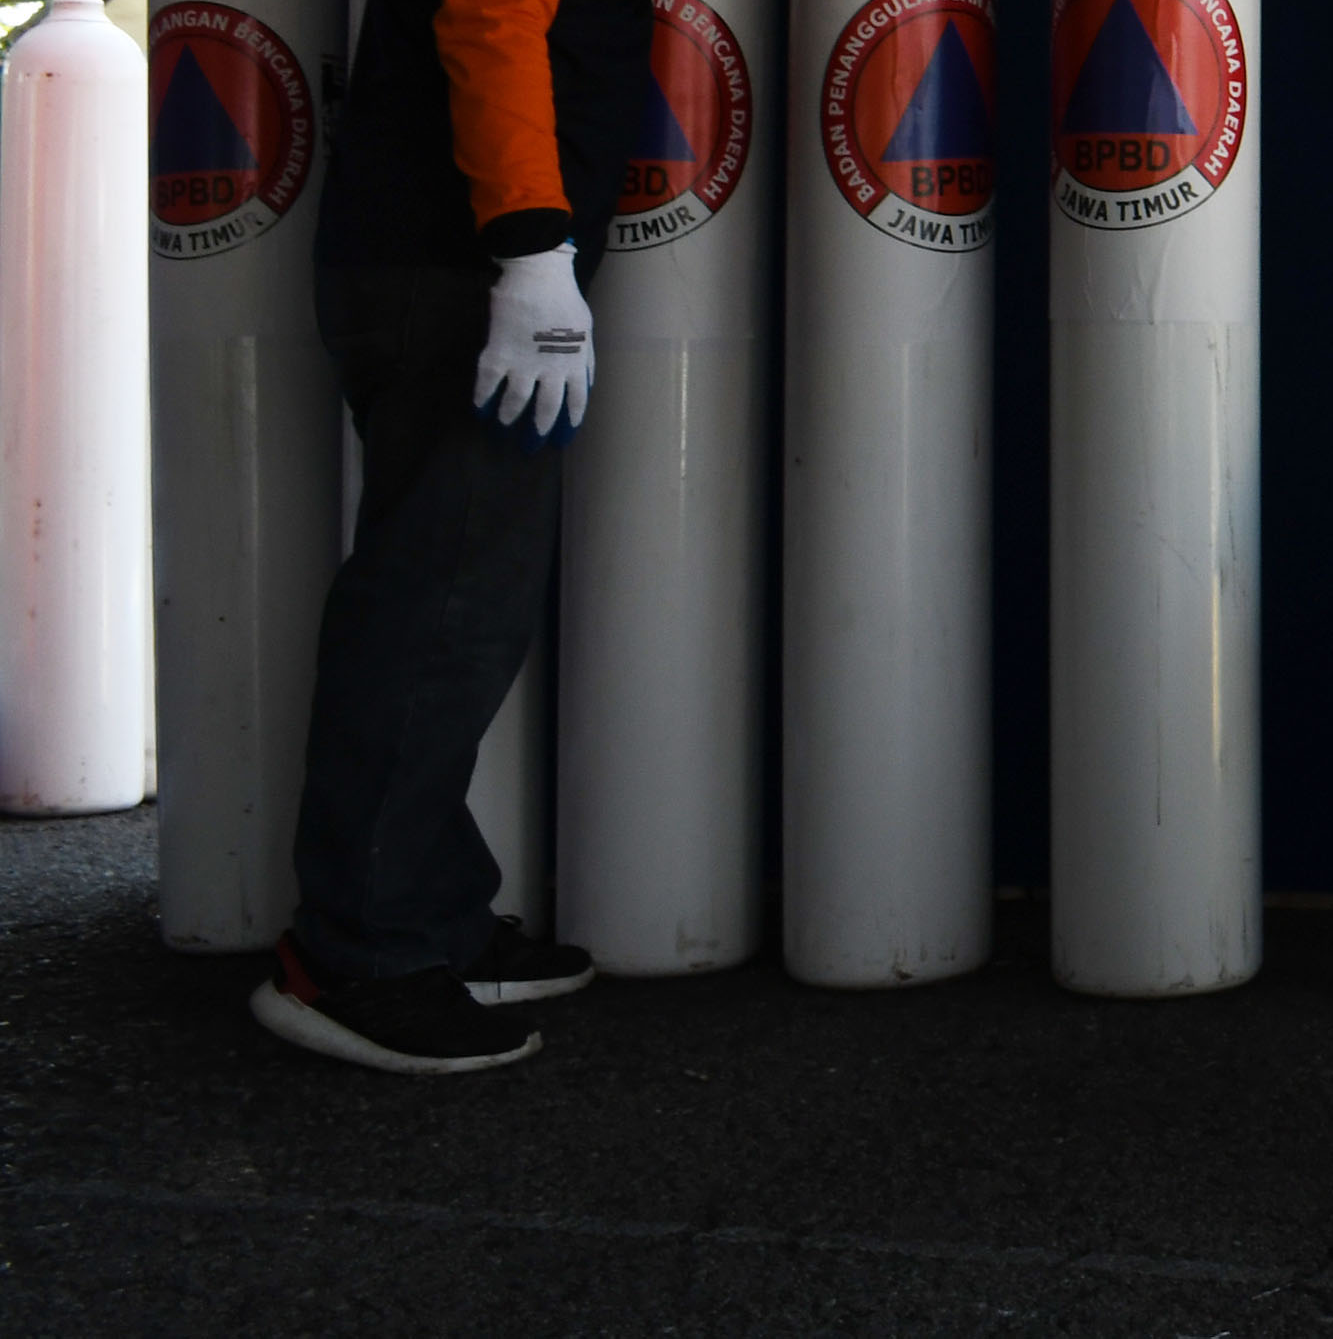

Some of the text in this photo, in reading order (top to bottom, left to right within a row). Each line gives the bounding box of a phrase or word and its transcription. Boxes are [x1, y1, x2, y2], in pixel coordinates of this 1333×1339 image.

[233, 18, 305, 112] BENCANA
[679, 2, 746, 202] BENCANA DAERAH
[268, 117, 309, 207] DAERAH
[829, 124, 876, 203] BADAN
[1074, 140, 1171, 172] BPBD
[1204, 80, 1243, 177] DAERAH
[616, 205, 696, 244] TIMUR
[888, 210, 955, 245] JAWA
[1060, 181, 1199, 222] JAWA TIMUR
